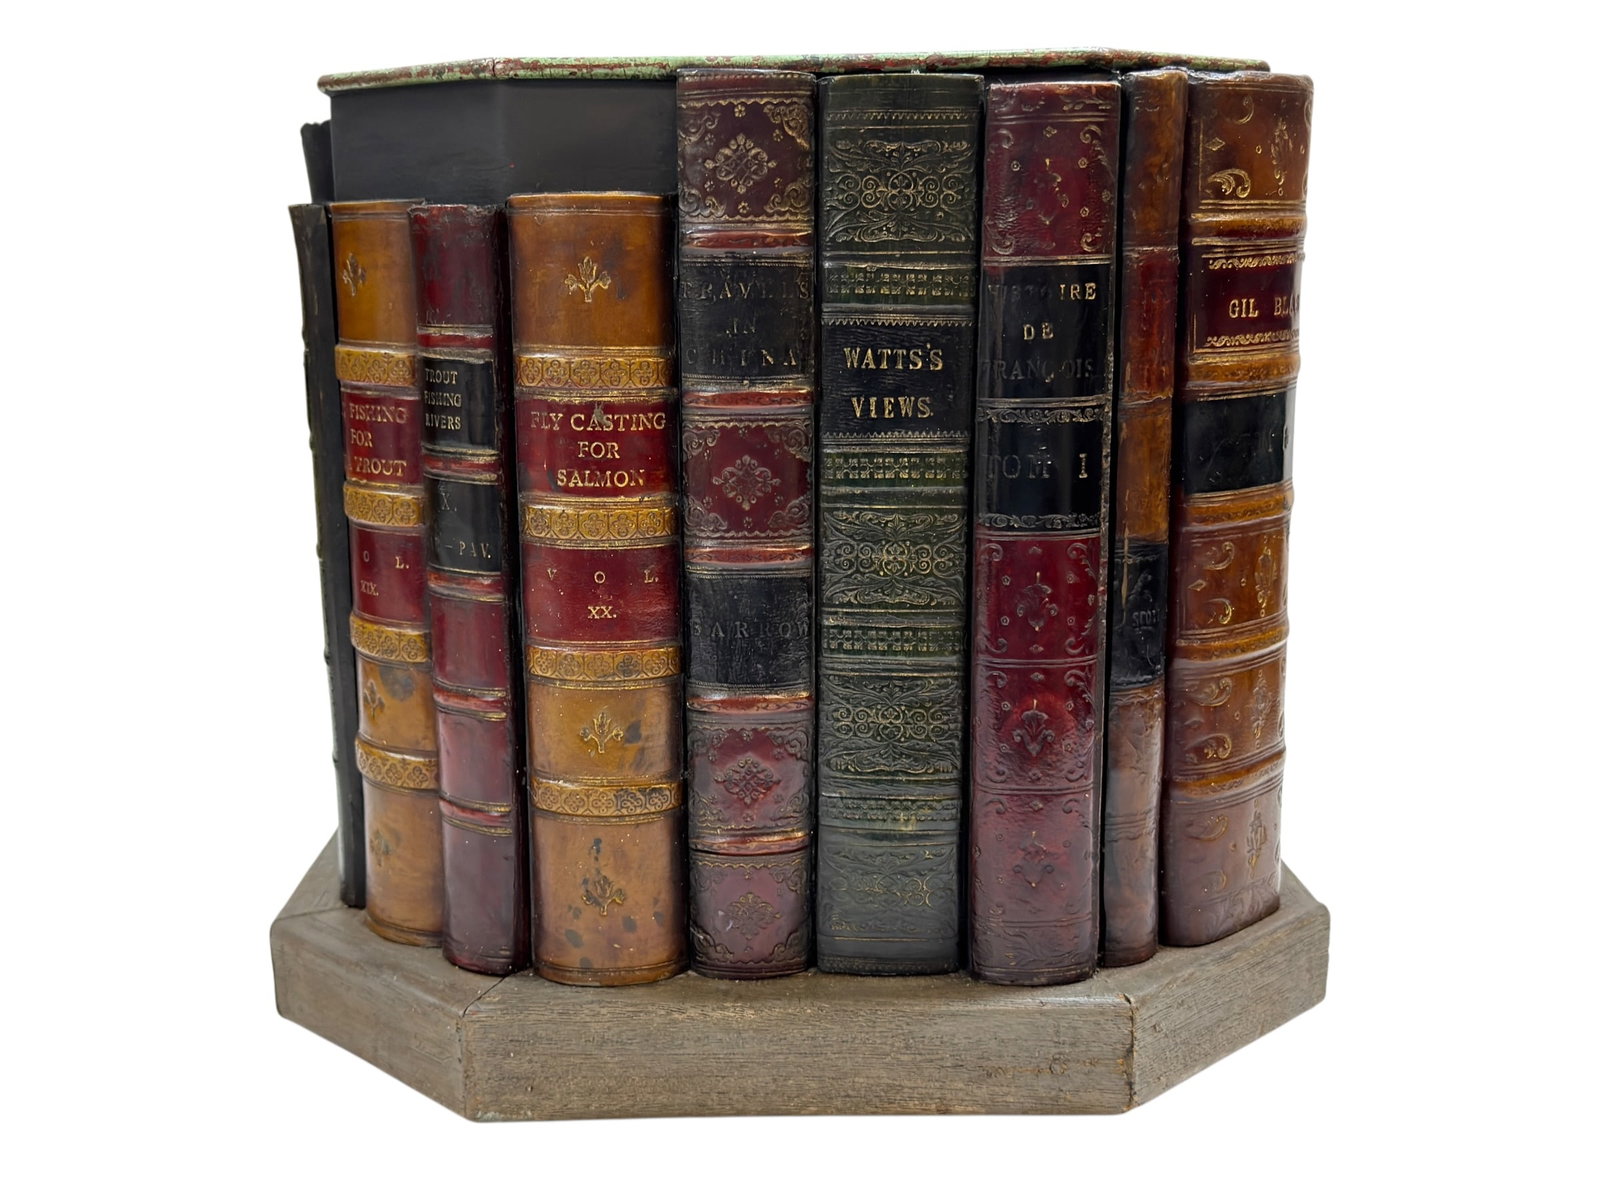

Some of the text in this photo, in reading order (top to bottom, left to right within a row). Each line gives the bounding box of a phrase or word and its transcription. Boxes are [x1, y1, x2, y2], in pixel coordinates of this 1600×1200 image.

[1229, 299, 1259, 319] GIL
[1023, 322, 1054, 340] DE
[843, 342, 944, 371] WATTS'S
[425, 368, 458, 384] TROUT
[424, 391, 462, 408] FISHING
[349, 403, 408, 424] FISHING
[425, 413, 462, 431] RIVERS
[530, 411, 667, 432] FLY CASTING
[350, 428, 373, 448] FOR
[577, 441, 621, 459] FOR
[352, 457, 407, 477] TROUT
[556, 468, 645, 488] SALMON
[587, 606, 617, 619] XX.
